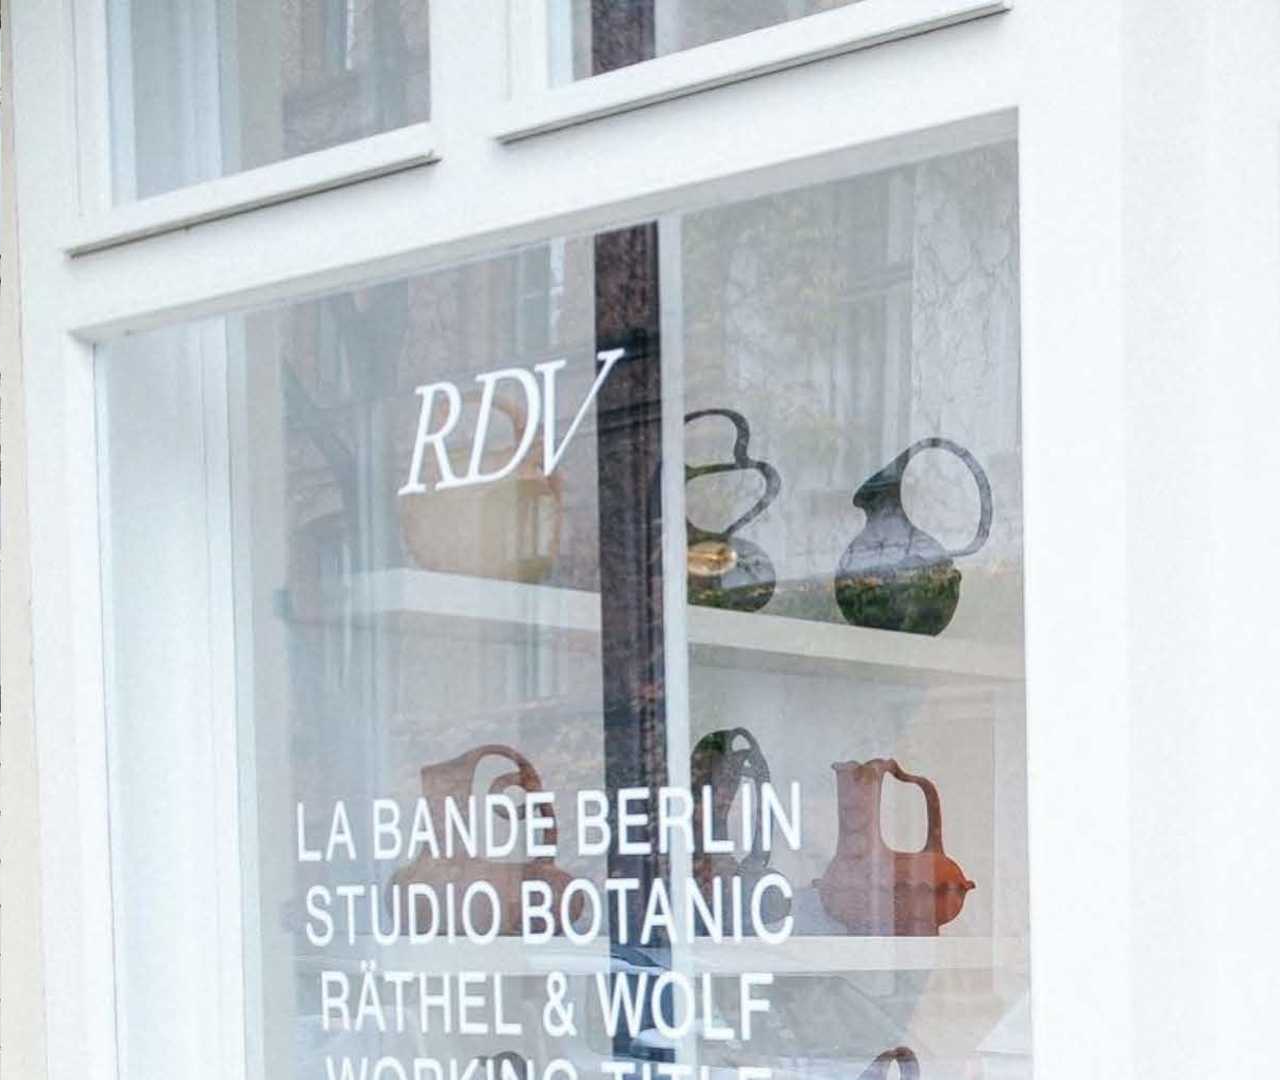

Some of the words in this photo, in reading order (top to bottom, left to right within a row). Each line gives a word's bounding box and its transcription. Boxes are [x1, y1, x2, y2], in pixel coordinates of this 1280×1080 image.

[397, 348, 625, 496] RDV
[297, 801, 357, 861] LA
[373, 791, 557, 860] BANDE
[577, 781, 801, 855] BERLIN
[306, 880, 502, 947] STUDIO
[521, 873, 794, 946] BOTANIC
[321, 961, 522, 1037] RÄTHEL
[543, 970, 577, 1038] &
[596, 972, 774, 1042] WOLF
